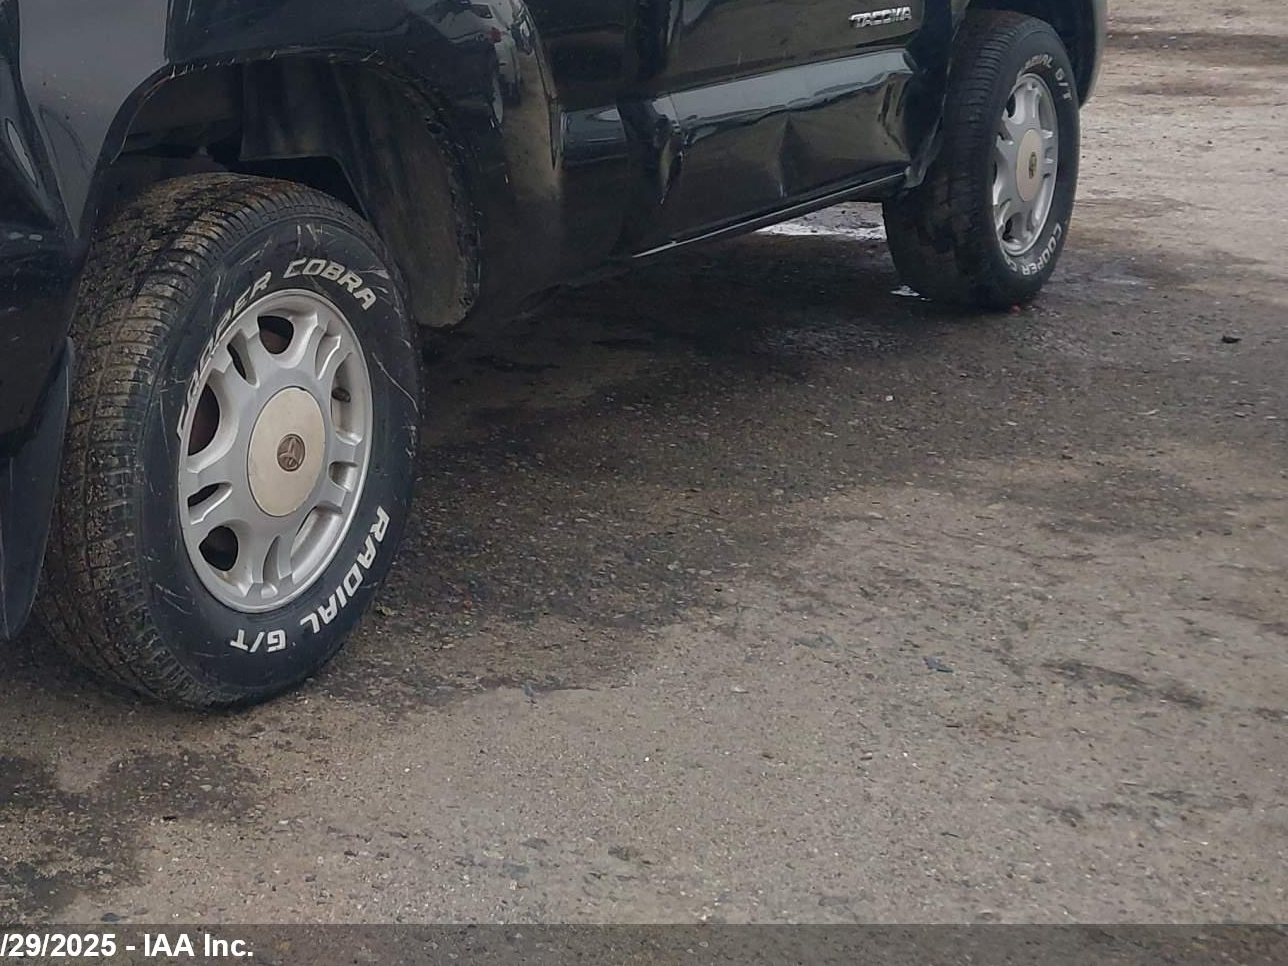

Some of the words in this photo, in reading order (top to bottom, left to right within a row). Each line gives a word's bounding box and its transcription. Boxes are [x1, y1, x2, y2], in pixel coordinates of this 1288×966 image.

[283, 257, 377, 311] COBRA
[300, 505, 391, 634] RADIAL
[229, 628, 287, 654] G/T
